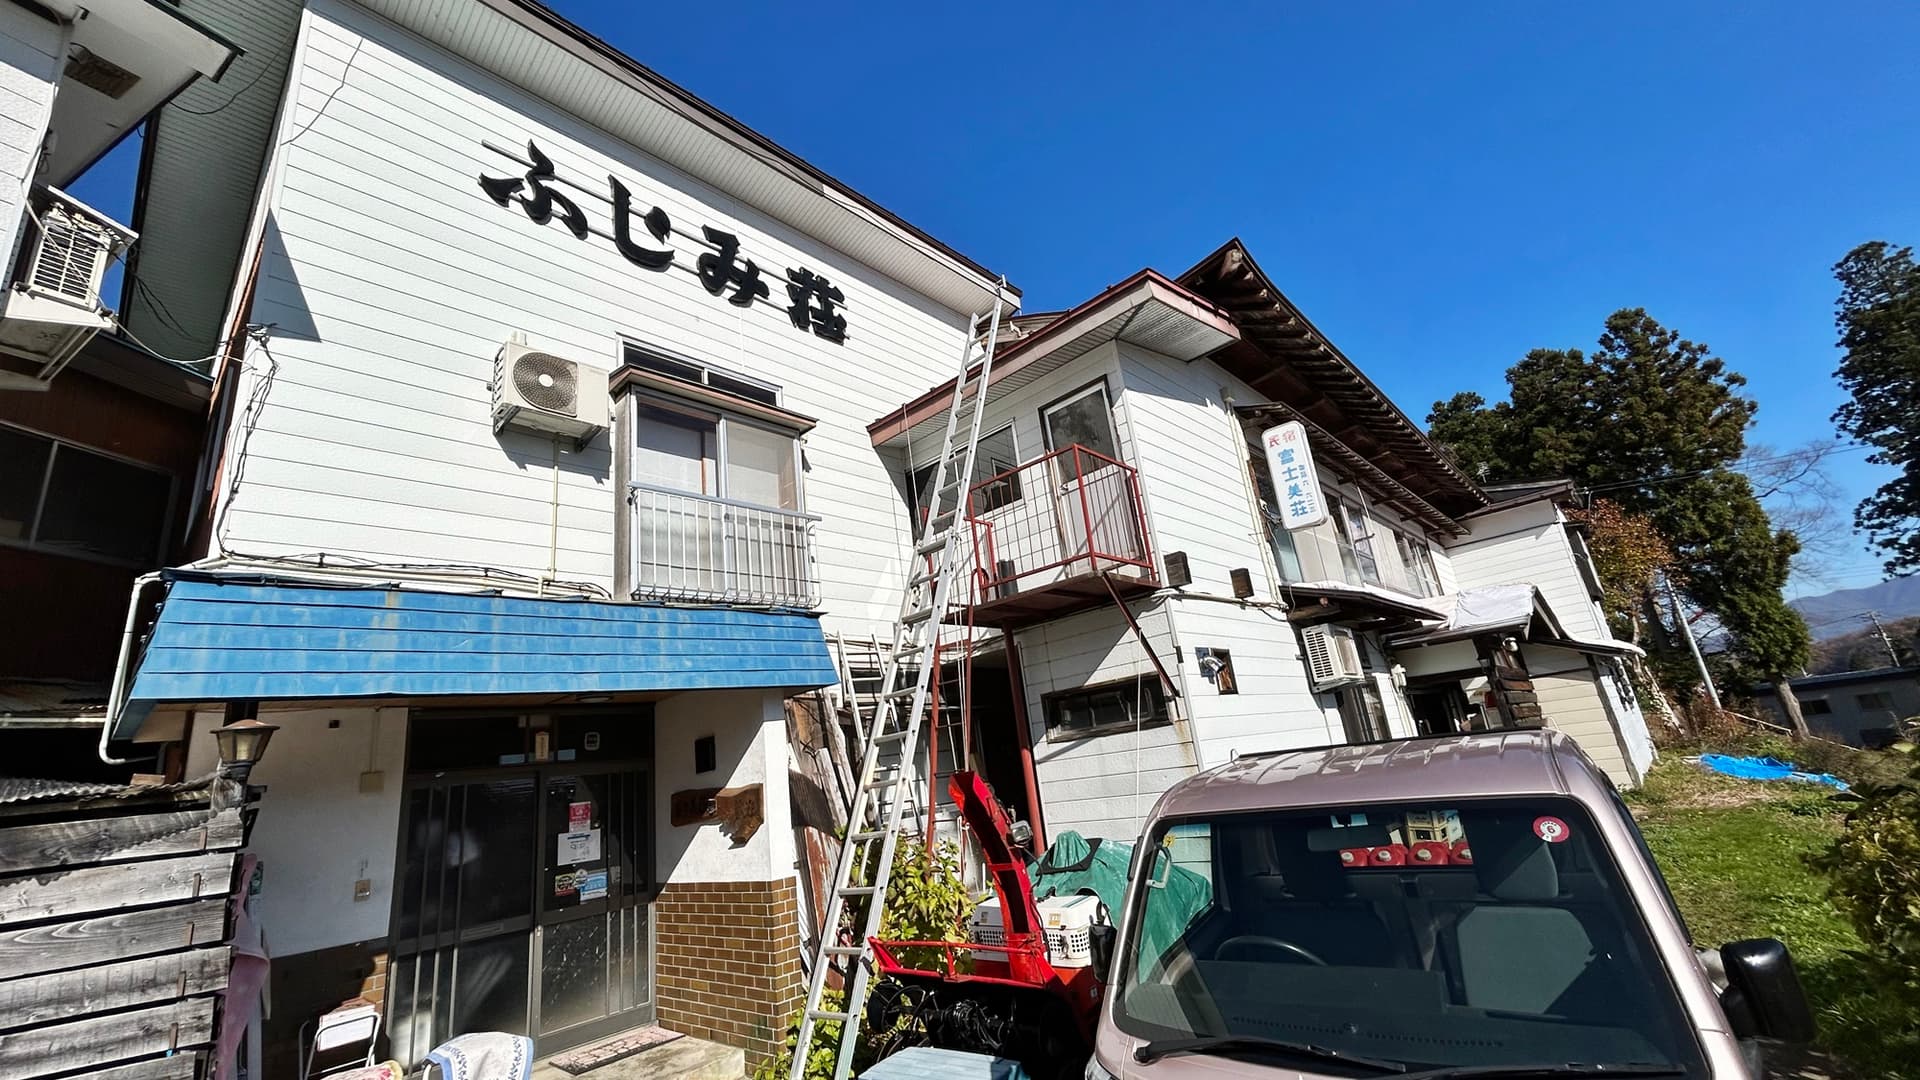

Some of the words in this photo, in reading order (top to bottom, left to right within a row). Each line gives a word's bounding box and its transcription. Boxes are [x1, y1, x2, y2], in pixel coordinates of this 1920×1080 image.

[478, 138, 847, 345] ふじみ荘
[1268, 430, 1296, 447] 民宿
[1277, 448, 1308, 517] 富士美荘
[1547, 825, 1556, 834] 6
